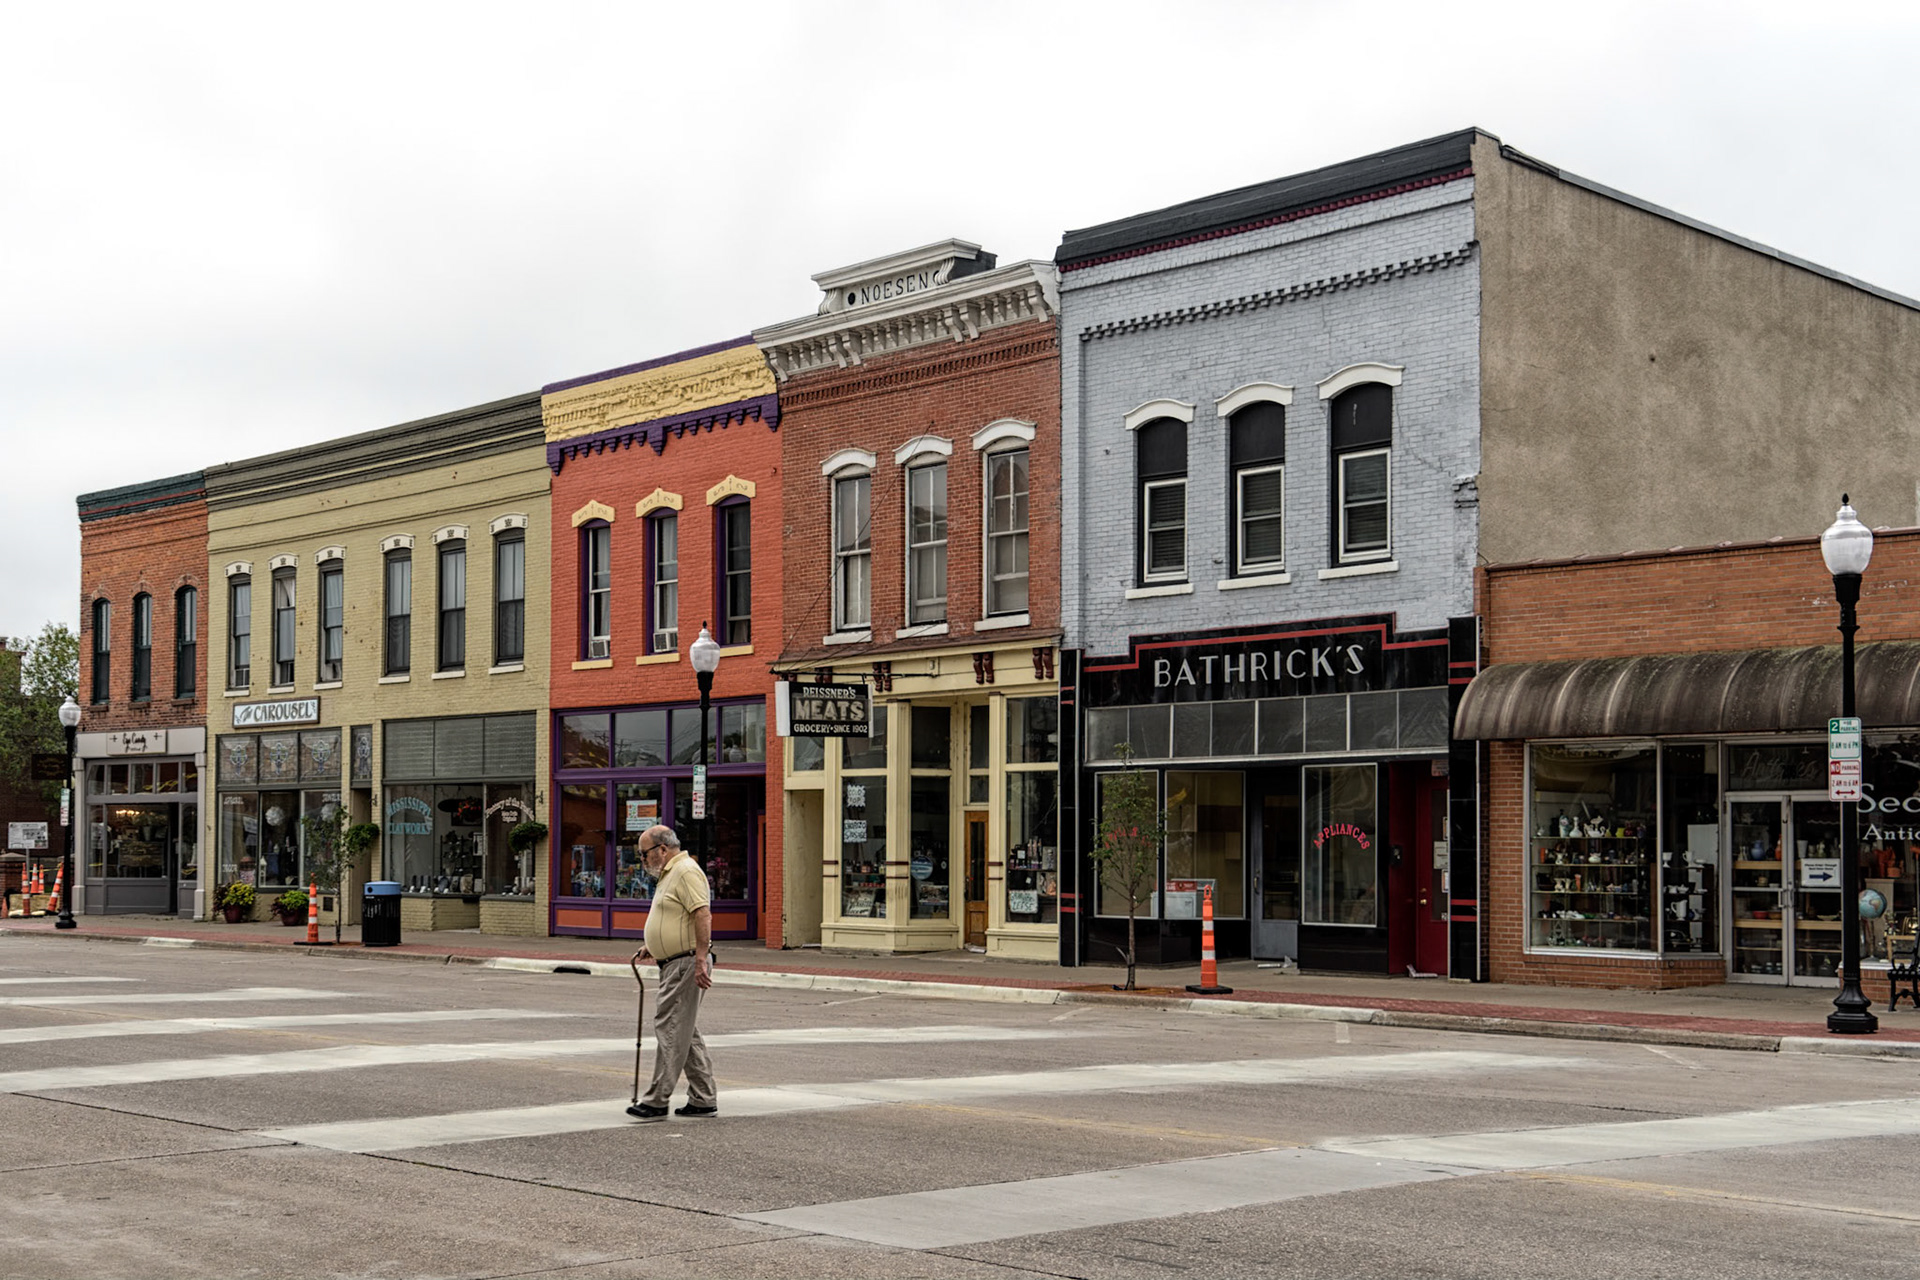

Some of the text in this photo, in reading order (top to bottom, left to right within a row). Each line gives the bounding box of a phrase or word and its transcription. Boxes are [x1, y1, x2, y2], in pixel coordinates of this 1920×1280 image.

[861, 271, 929, 305] NOESEN
[1154, 644, 1365, 688] BATHRICK'S
[802, 686, 856, 699] REISSNER'S
[253, 701, 313, 722] CAROUSEL
[795, 699, 865, 721] MEATS
[833, 724, 851, 734] SINCE
[852, 724, 868, 734] 1902
[1831, 721, 1839, 732] 2
[1313, 823, 1370, 849] APPLIANCES
